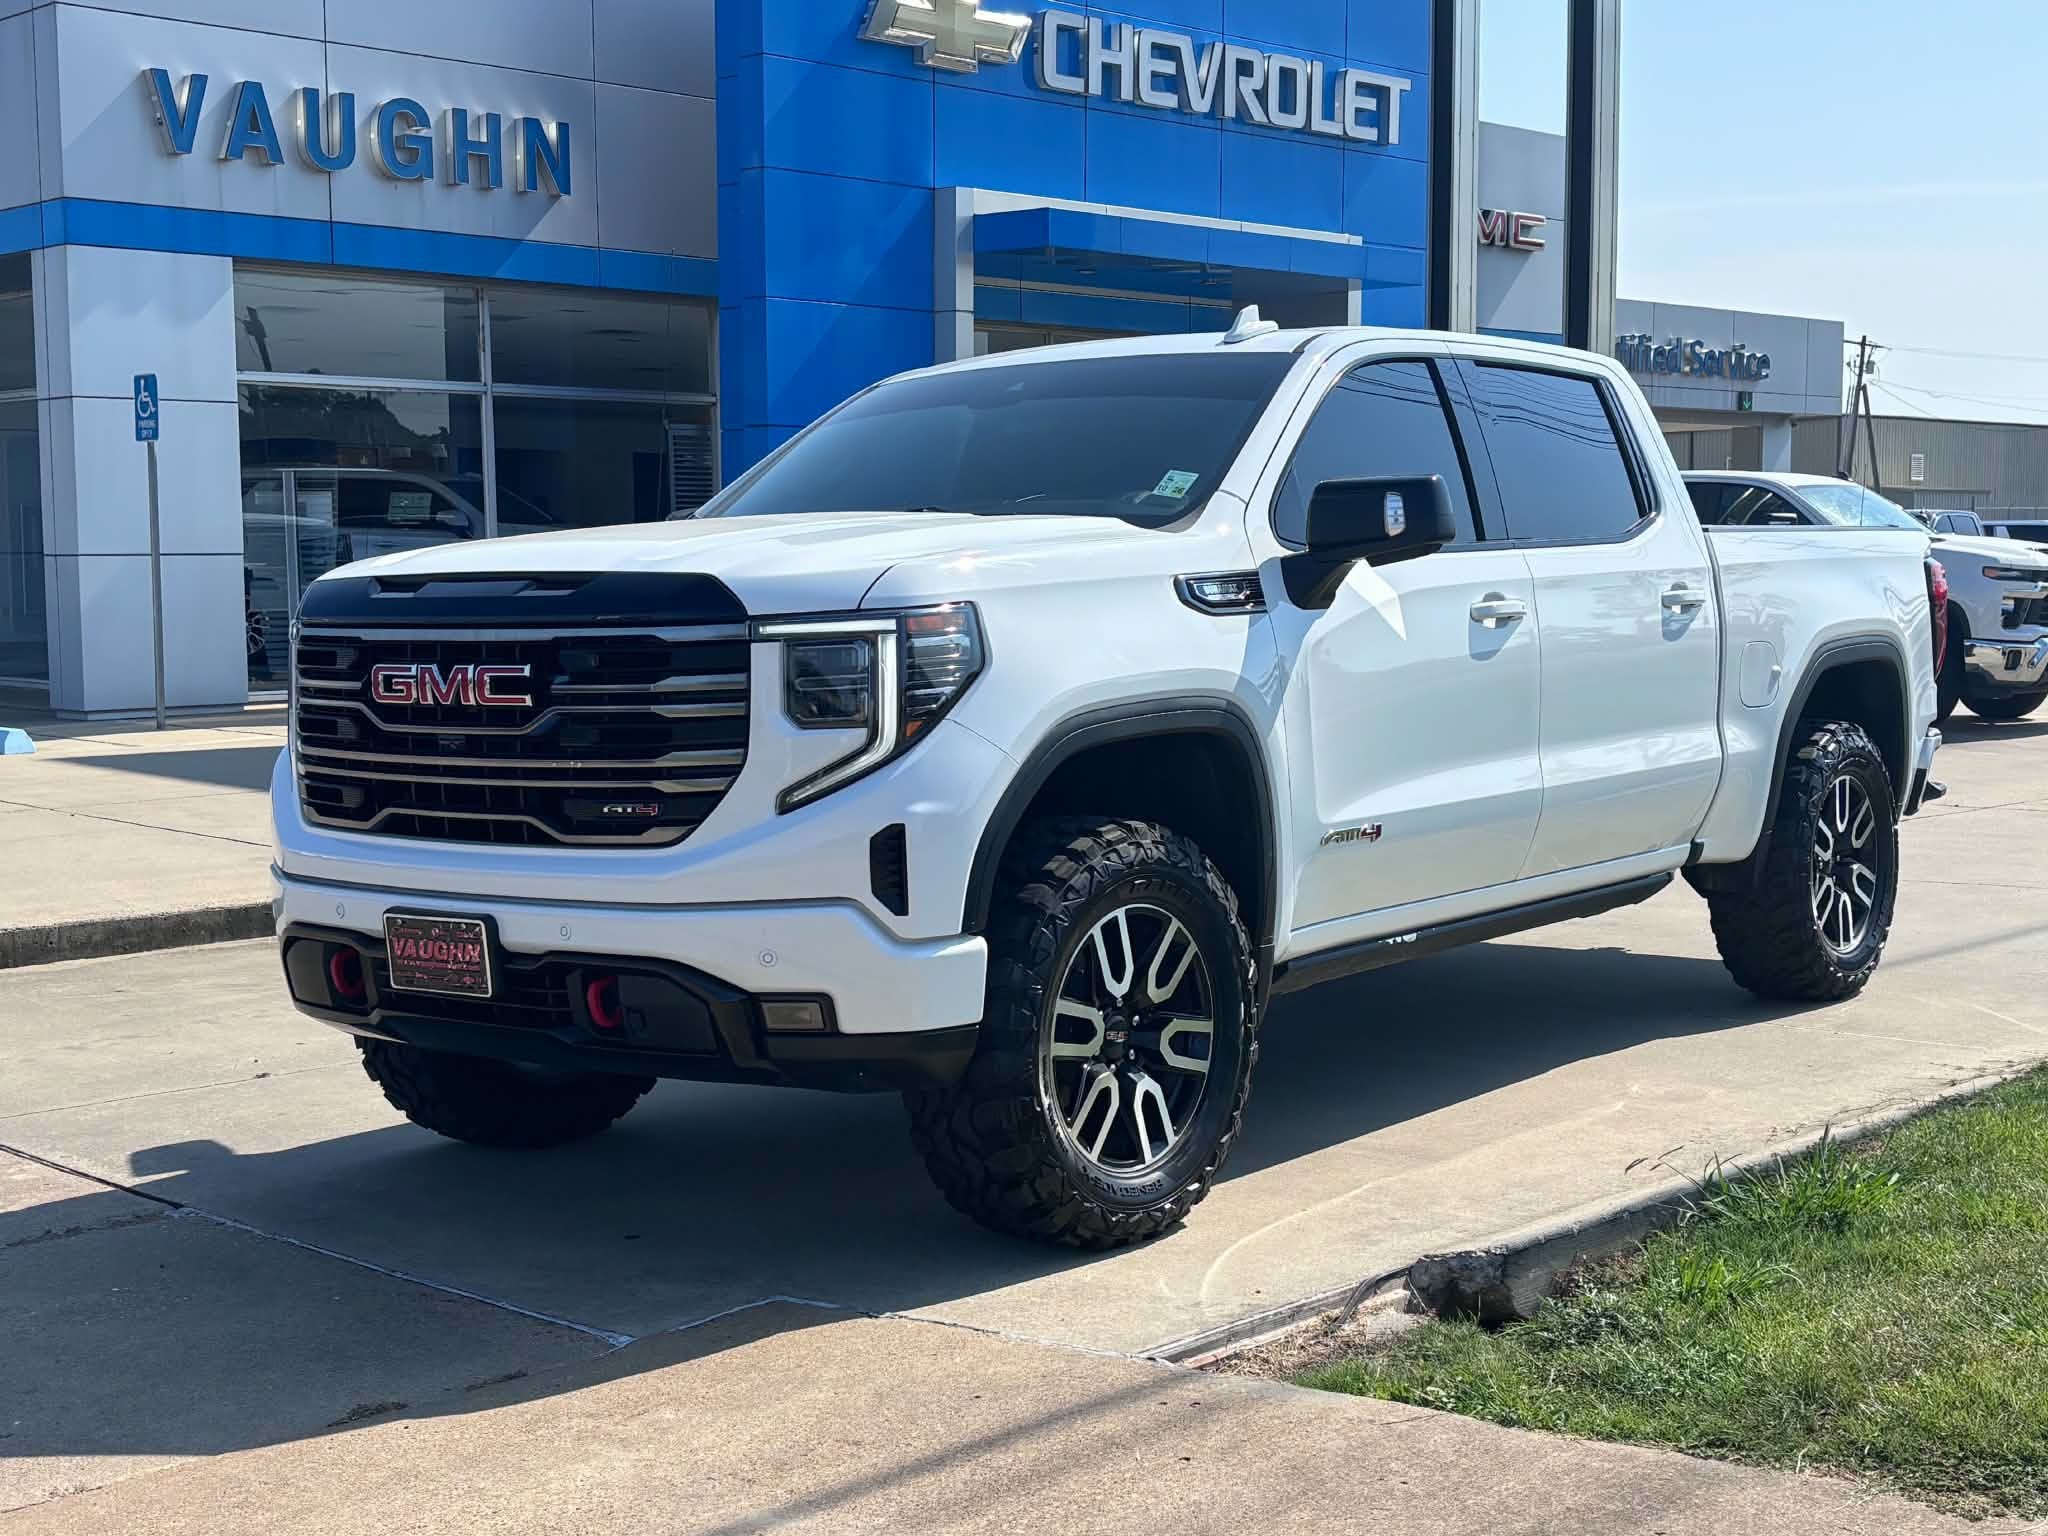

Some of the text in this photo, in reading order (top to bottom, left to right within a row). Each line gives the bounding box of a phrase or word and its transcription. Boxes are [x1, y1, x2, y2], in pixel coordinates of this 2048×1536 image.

[1034, 8, 1412, 146] CHEVROLET
[143, 66, 573, 198] VAUGHN
[1686, 338, 1772, 382] Service
[371, 663, 533, 707] GMC
[391, 936, 481, 962] VAUGHN
